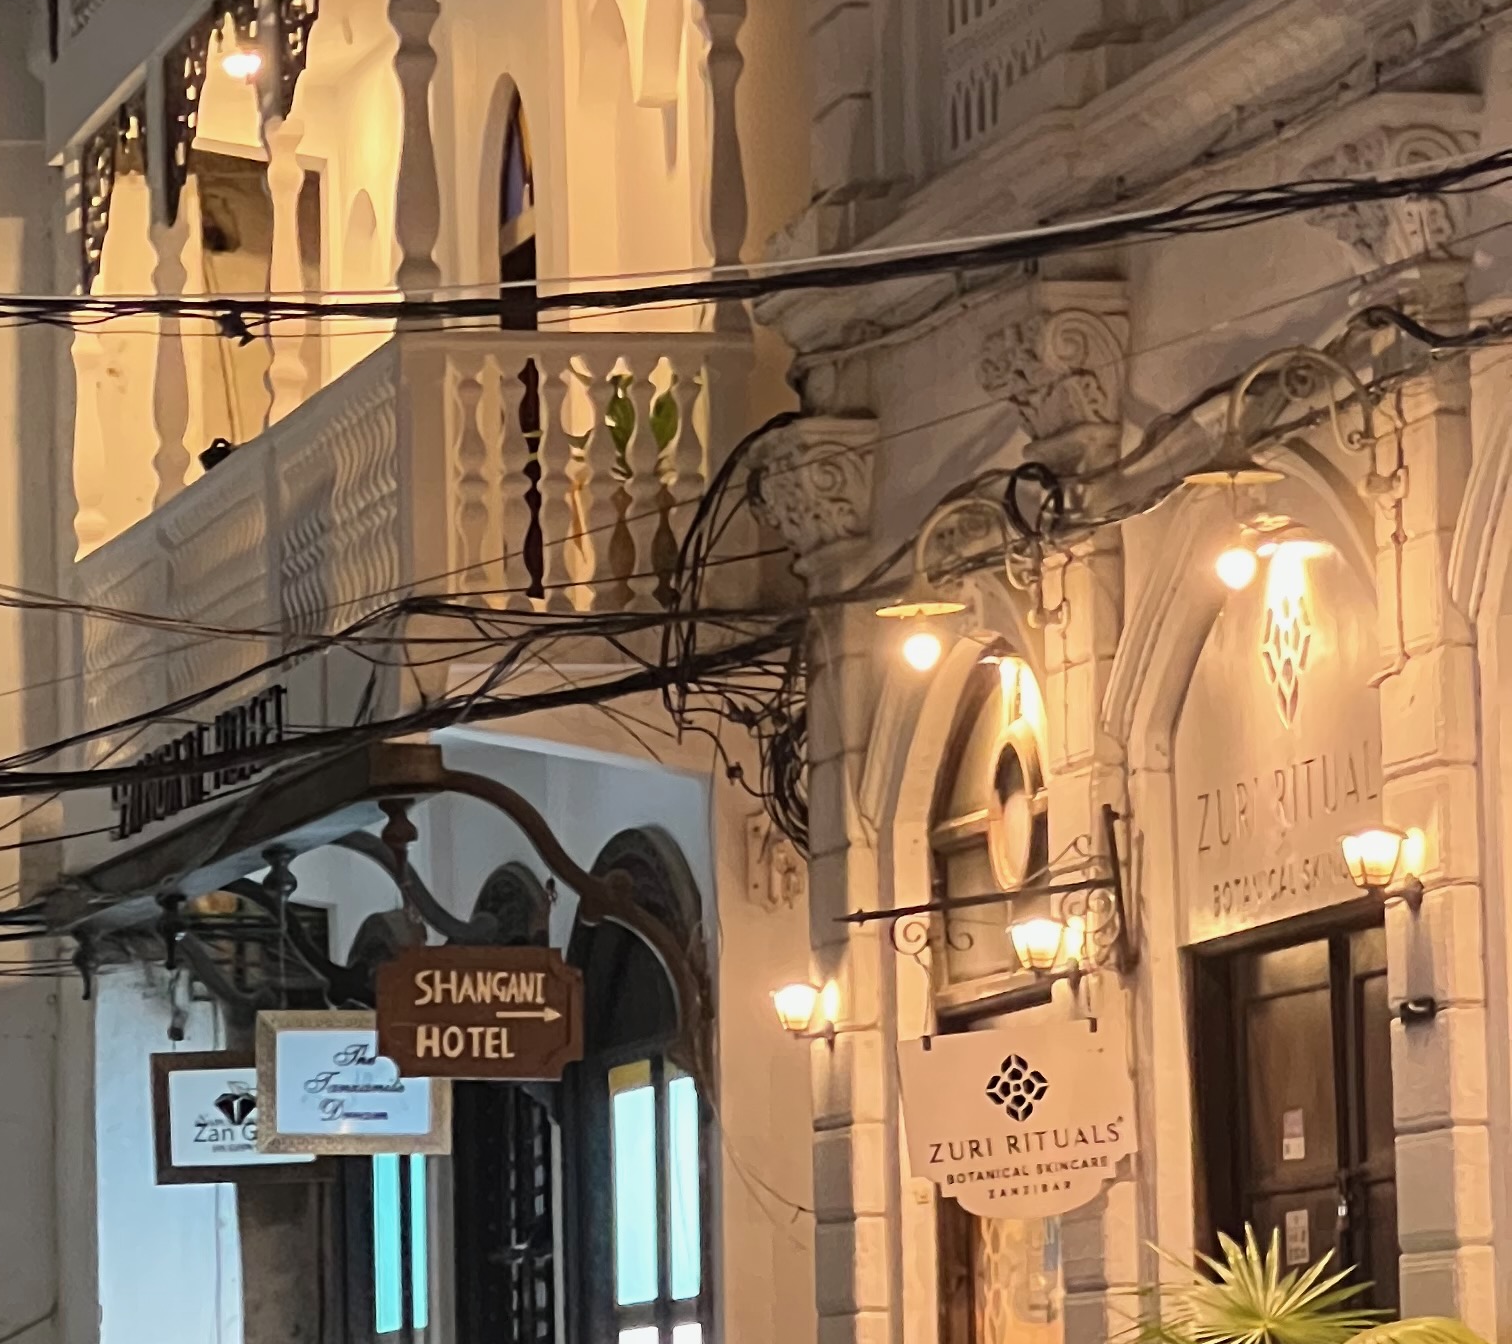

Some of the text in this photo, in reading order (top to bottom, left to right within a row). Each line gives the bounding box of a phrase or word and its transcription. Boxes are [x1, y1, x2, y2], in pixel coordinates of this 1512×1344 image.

[1197, 776, 1260, 853] ZURI
[414, 969, 546, 1006] SHANGANI
[416, 1025, 515, 1058] HOTEL
[193, 1122, 235, 1142] Zan
[929, 1122, 1120, 1164] ZURI RITUALS
[946, 1155, 1109, 1185] BOTANICAL SKINCARE
